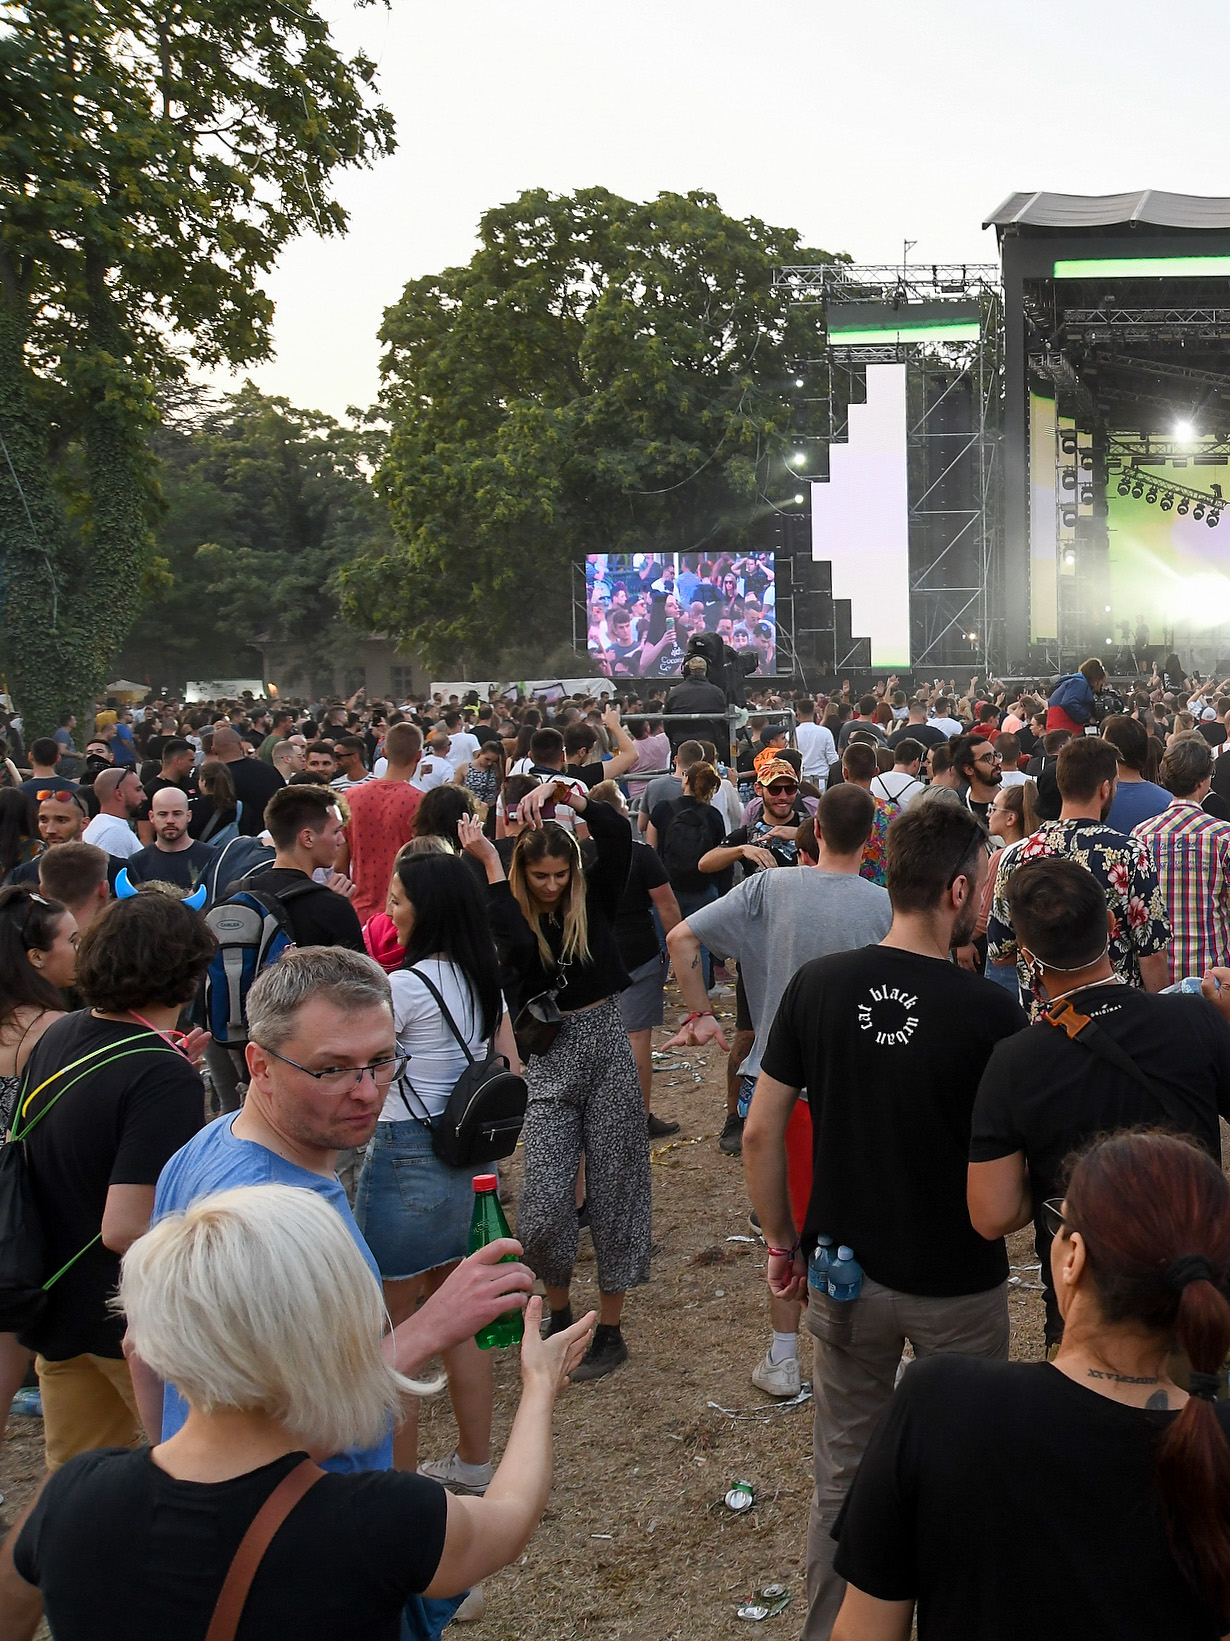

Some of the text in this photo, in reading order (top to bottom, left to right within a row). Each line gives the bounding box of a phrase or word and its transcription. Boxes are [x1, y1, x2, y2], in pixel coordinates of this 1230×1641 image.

[858, 984, 919, 1045] black urban cat
